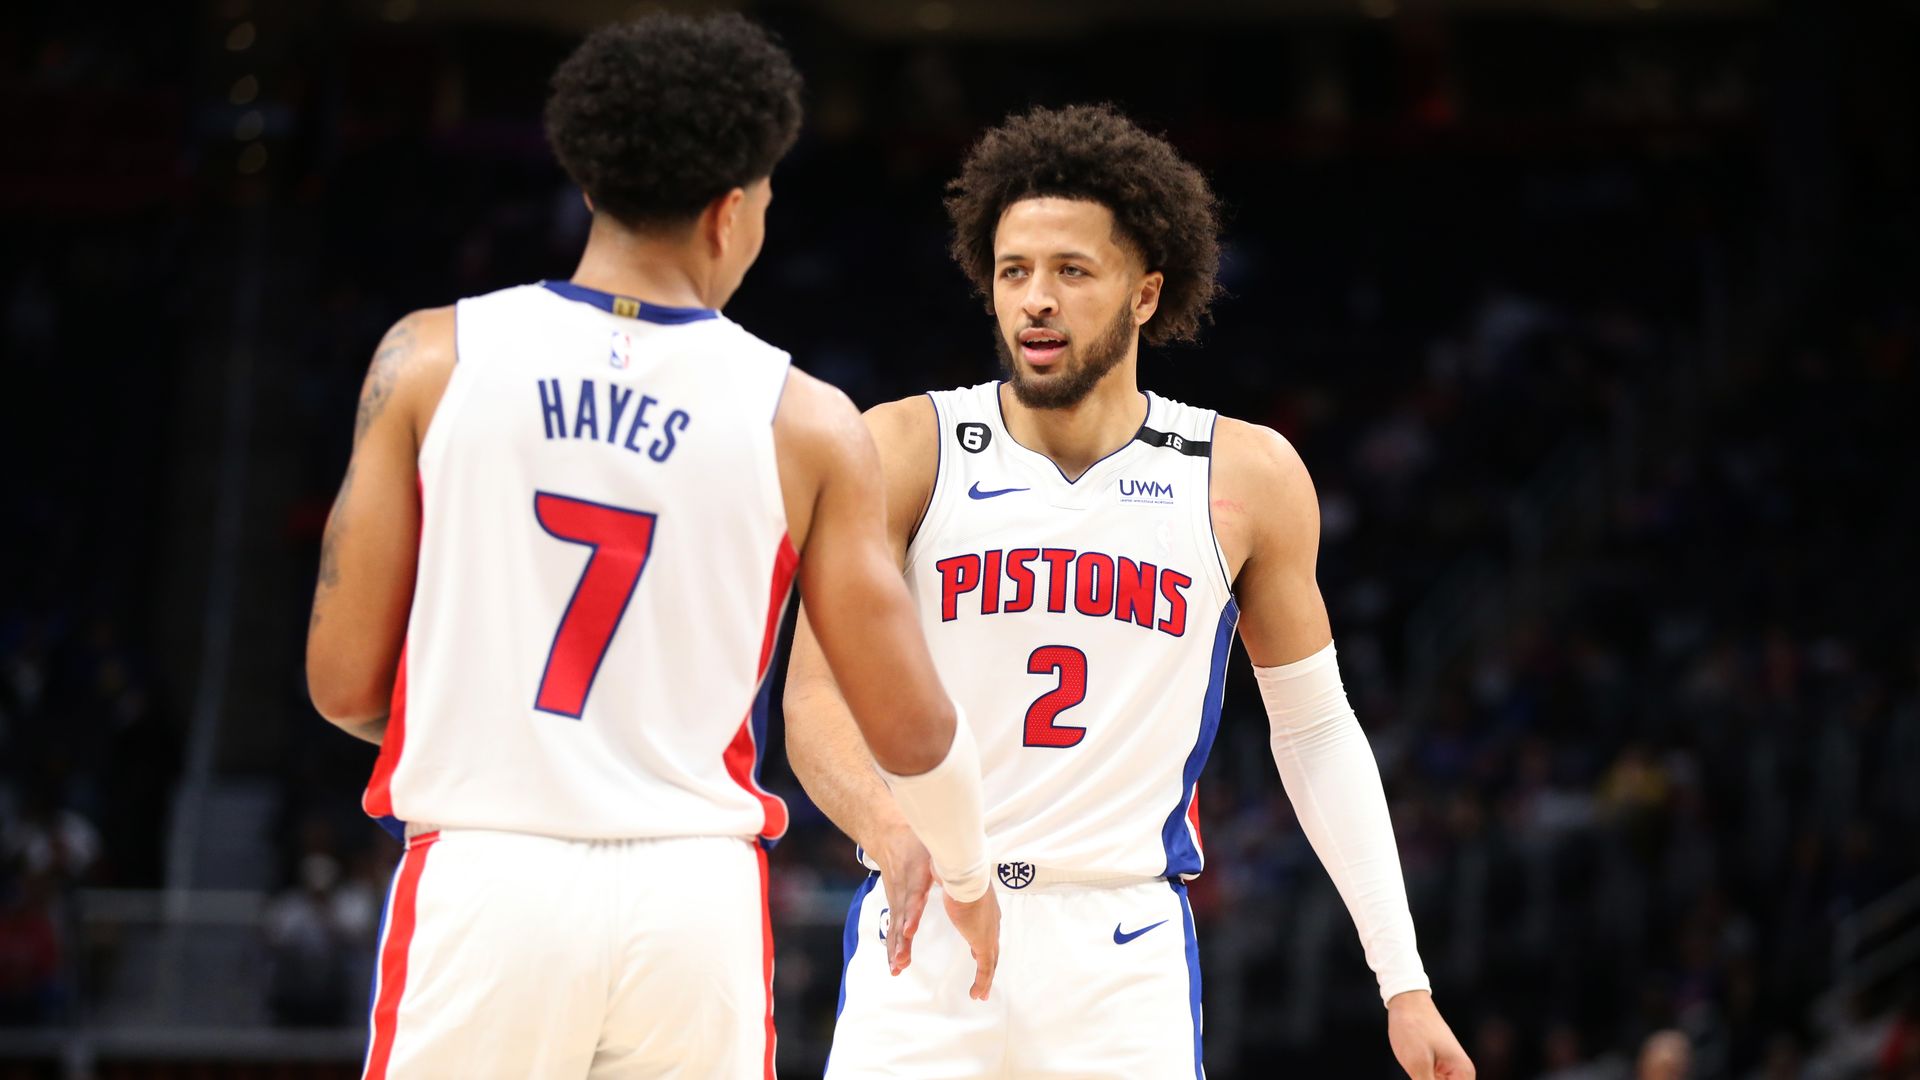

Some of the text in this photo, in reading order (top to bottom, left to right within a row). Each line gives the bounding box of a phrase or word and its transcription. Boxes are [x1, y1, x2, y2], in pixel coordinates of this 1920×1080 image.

[537, 378, 691, 463] HAYES
[963, 426, 984, 450] 6
[1165, 434, 1183, 450] 16
[1119, 479, 1173, 498] UWM
[534, 489, 658, 721] 7
[936, 547, 1192, 638] PISTONS
[1022, 644, 1088, 749] 2
